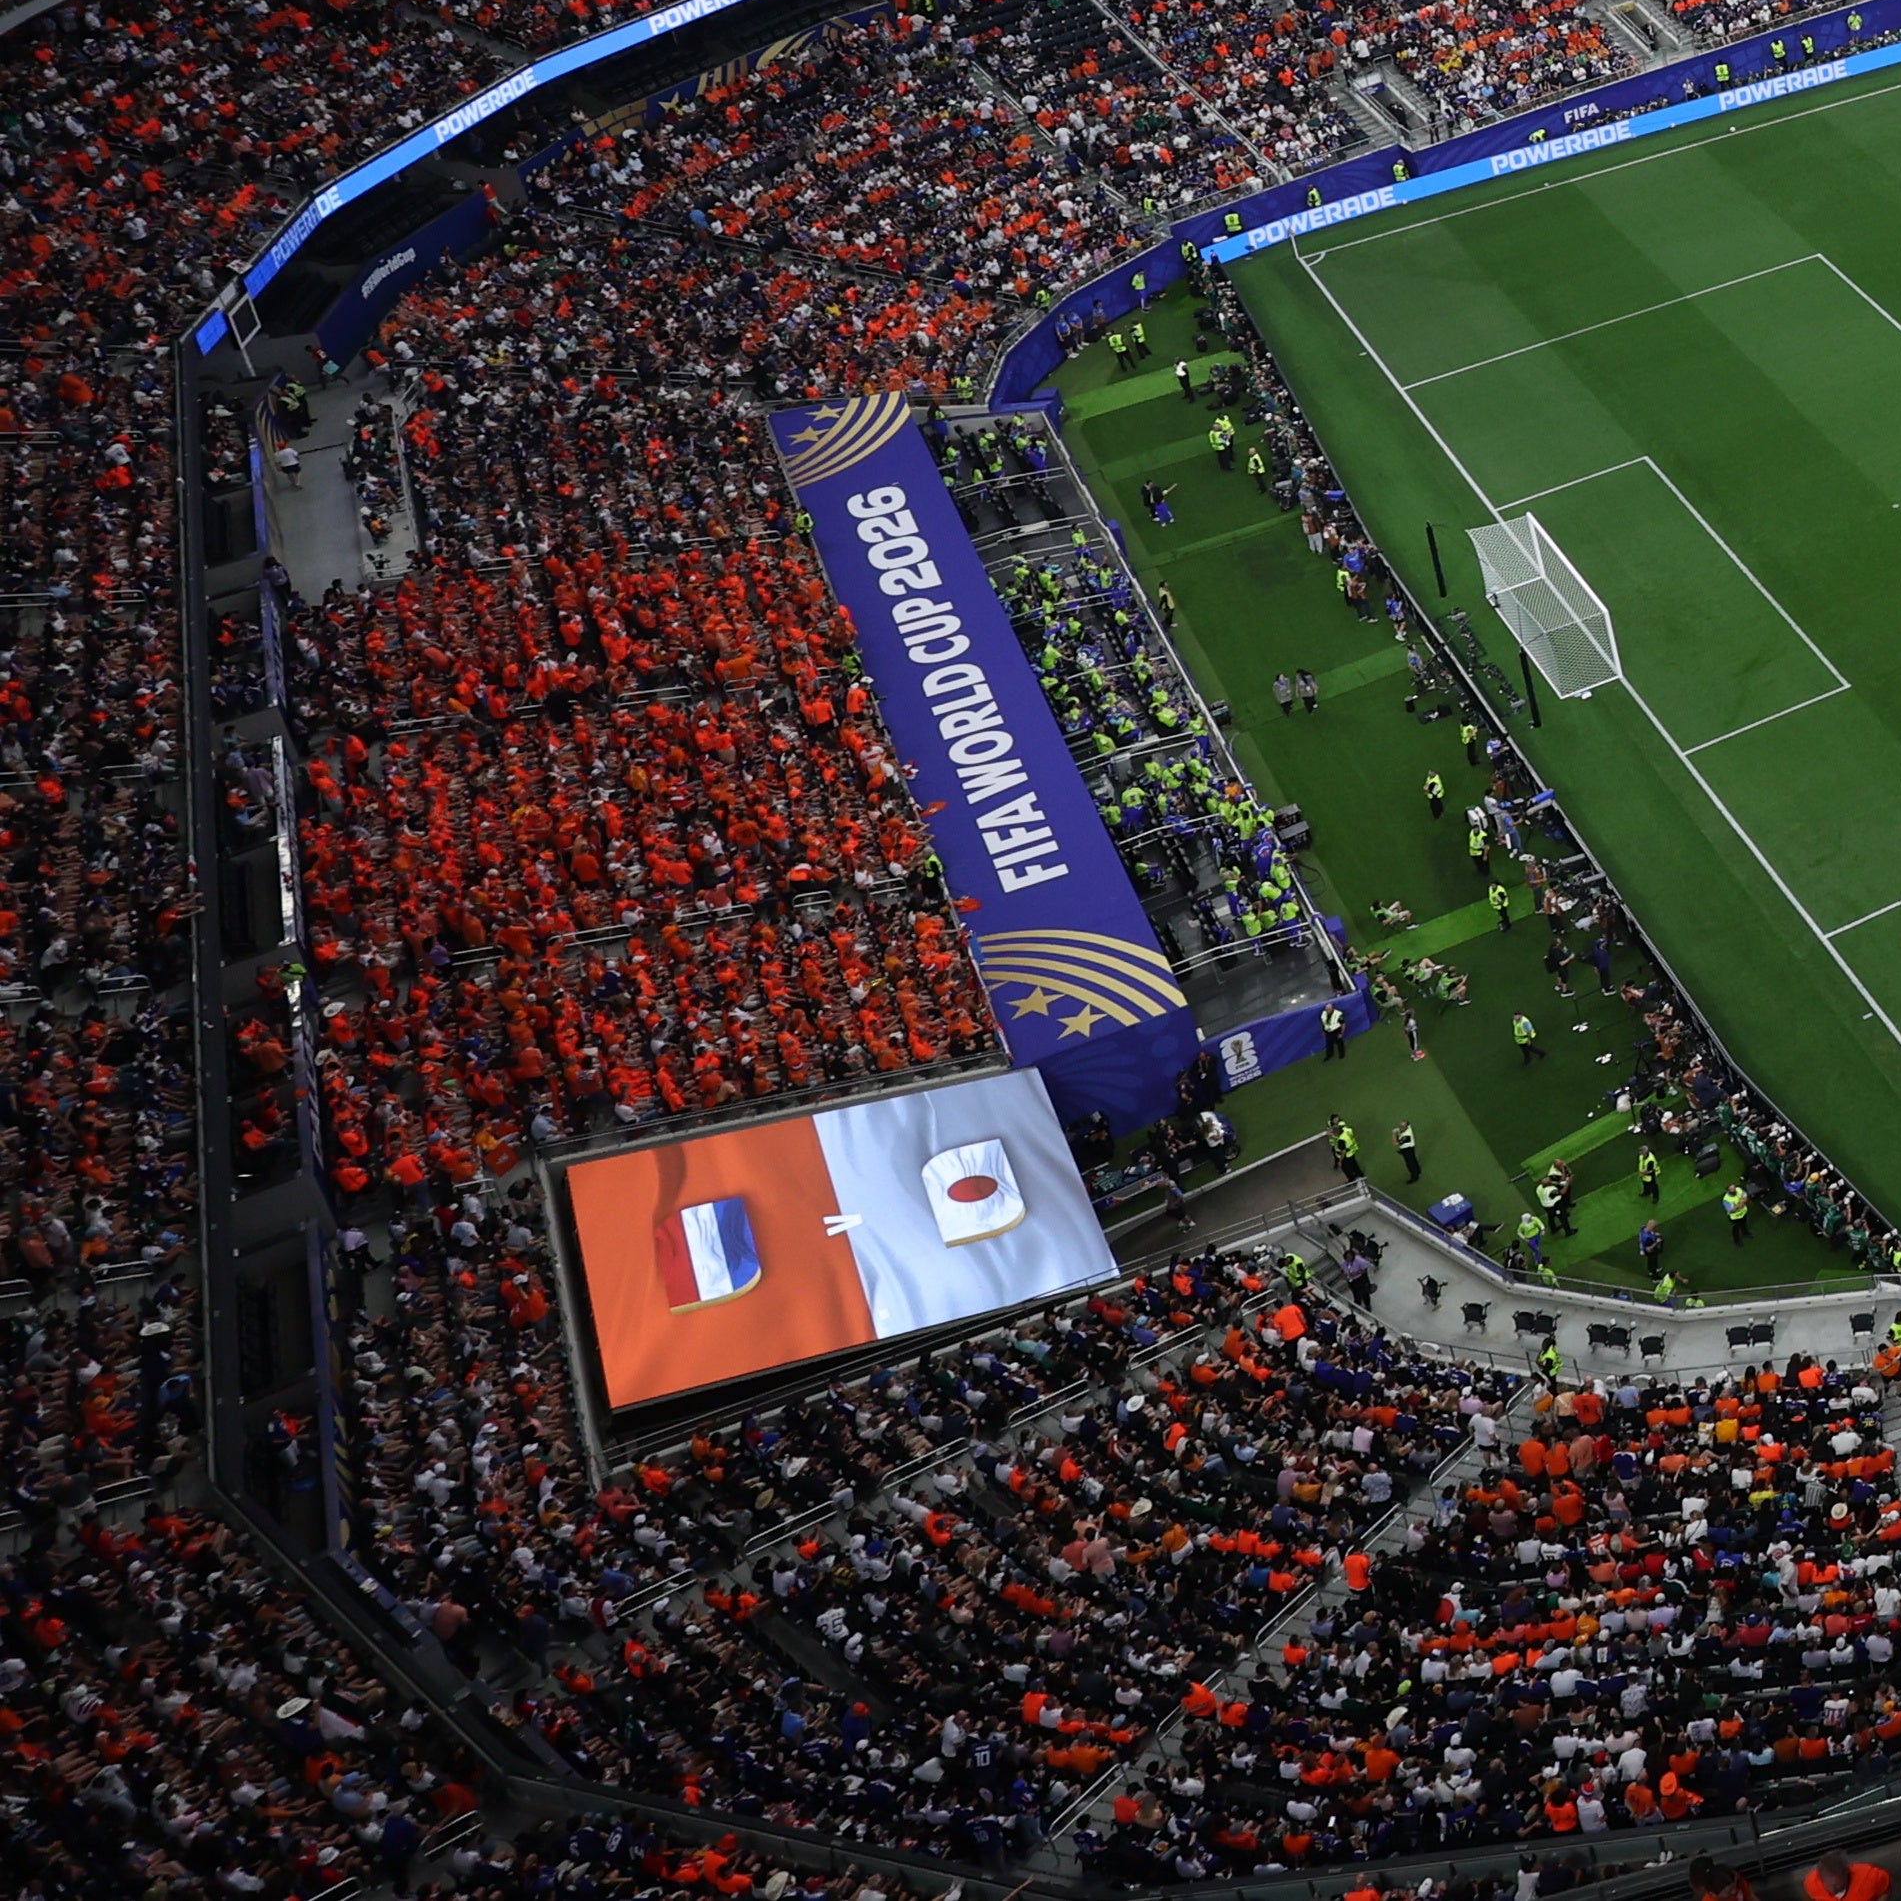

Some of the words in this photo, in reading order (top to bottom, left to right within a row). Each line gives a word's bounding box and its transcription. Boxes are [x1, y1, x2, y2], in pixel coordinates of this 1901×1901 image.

[434, 68, 536, 142] POWERADE
[1564, 102, 1599, 124] FIFA
[1492, 121, 1631, 174] POWERADE
[1247, 185, 1395, 248] POWERADE
[846, 486, 943, 596] 2026
[891, 597, 971, 664] CUP
[922, 663, 1029, 805] WORLD
[976, 791, 1068, 893] FIFA
